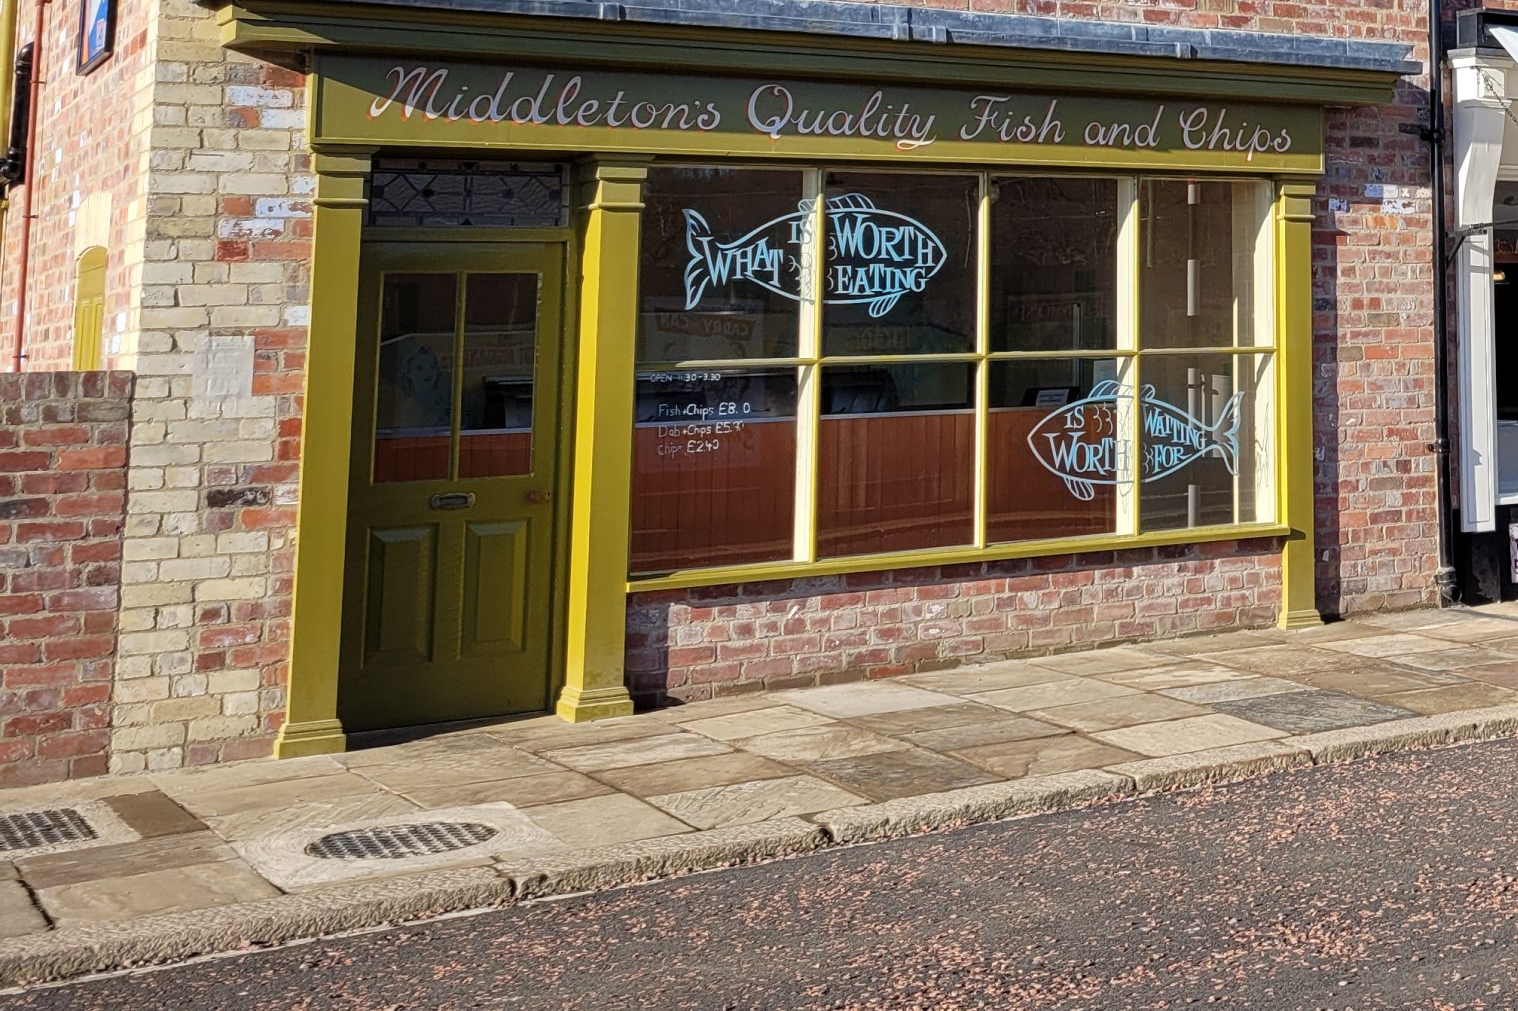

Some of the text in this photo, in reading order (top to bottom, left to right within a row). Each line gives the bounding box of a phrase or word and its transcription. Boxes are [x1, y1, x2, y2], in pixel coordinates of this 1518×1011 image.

[369, 66, 1292, 162] Middleton's Quality Fish and Chips
[696, 213, 936, 287] WHAT IS WORTH
[833, 264, 930, 295] EATING
[1064, 404, 1085, 429] IS
[1141, 404, 1206, 450] WAITING
[1041, 431, 1132, 476] WORTH
[1152, 444, 1193, 474] FOR
